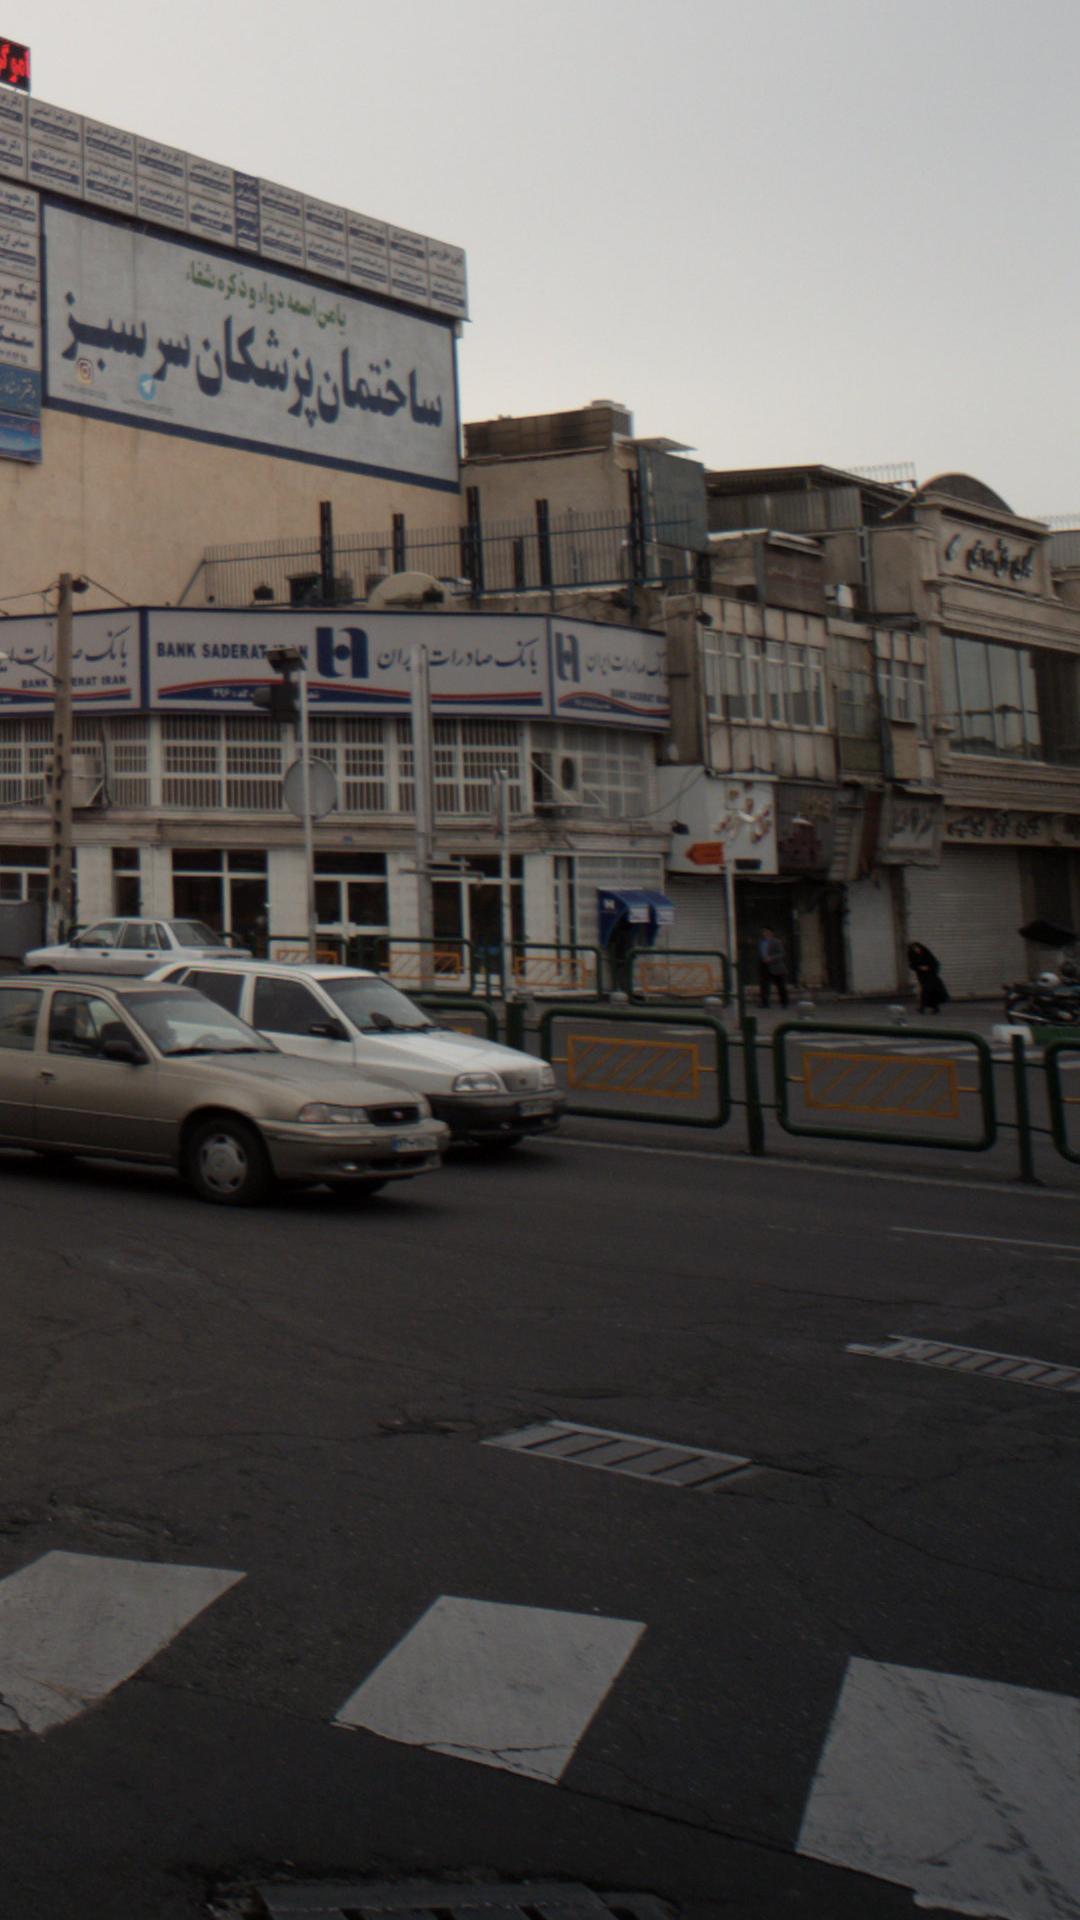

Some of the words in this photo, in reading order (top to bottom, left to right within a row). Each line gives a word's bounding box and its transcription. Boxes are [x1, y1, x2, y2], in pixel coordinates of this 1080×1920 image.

[287, 292, 317, 317] اسمه
[196, 315, 313, 427] پزشکان
[317, 347, 443, 427] ساختمان
[85, 624, 131, 668] بانک
[156, 641, 197, 659] BANK
[201, 642, 268, 659] SADERAT
[428, 647, 493, 667] صادرات
[495, 637, 540, 674] بانک
[21, 679, 48, 689] BANK
[101, 675, 127, 686] IRAN
